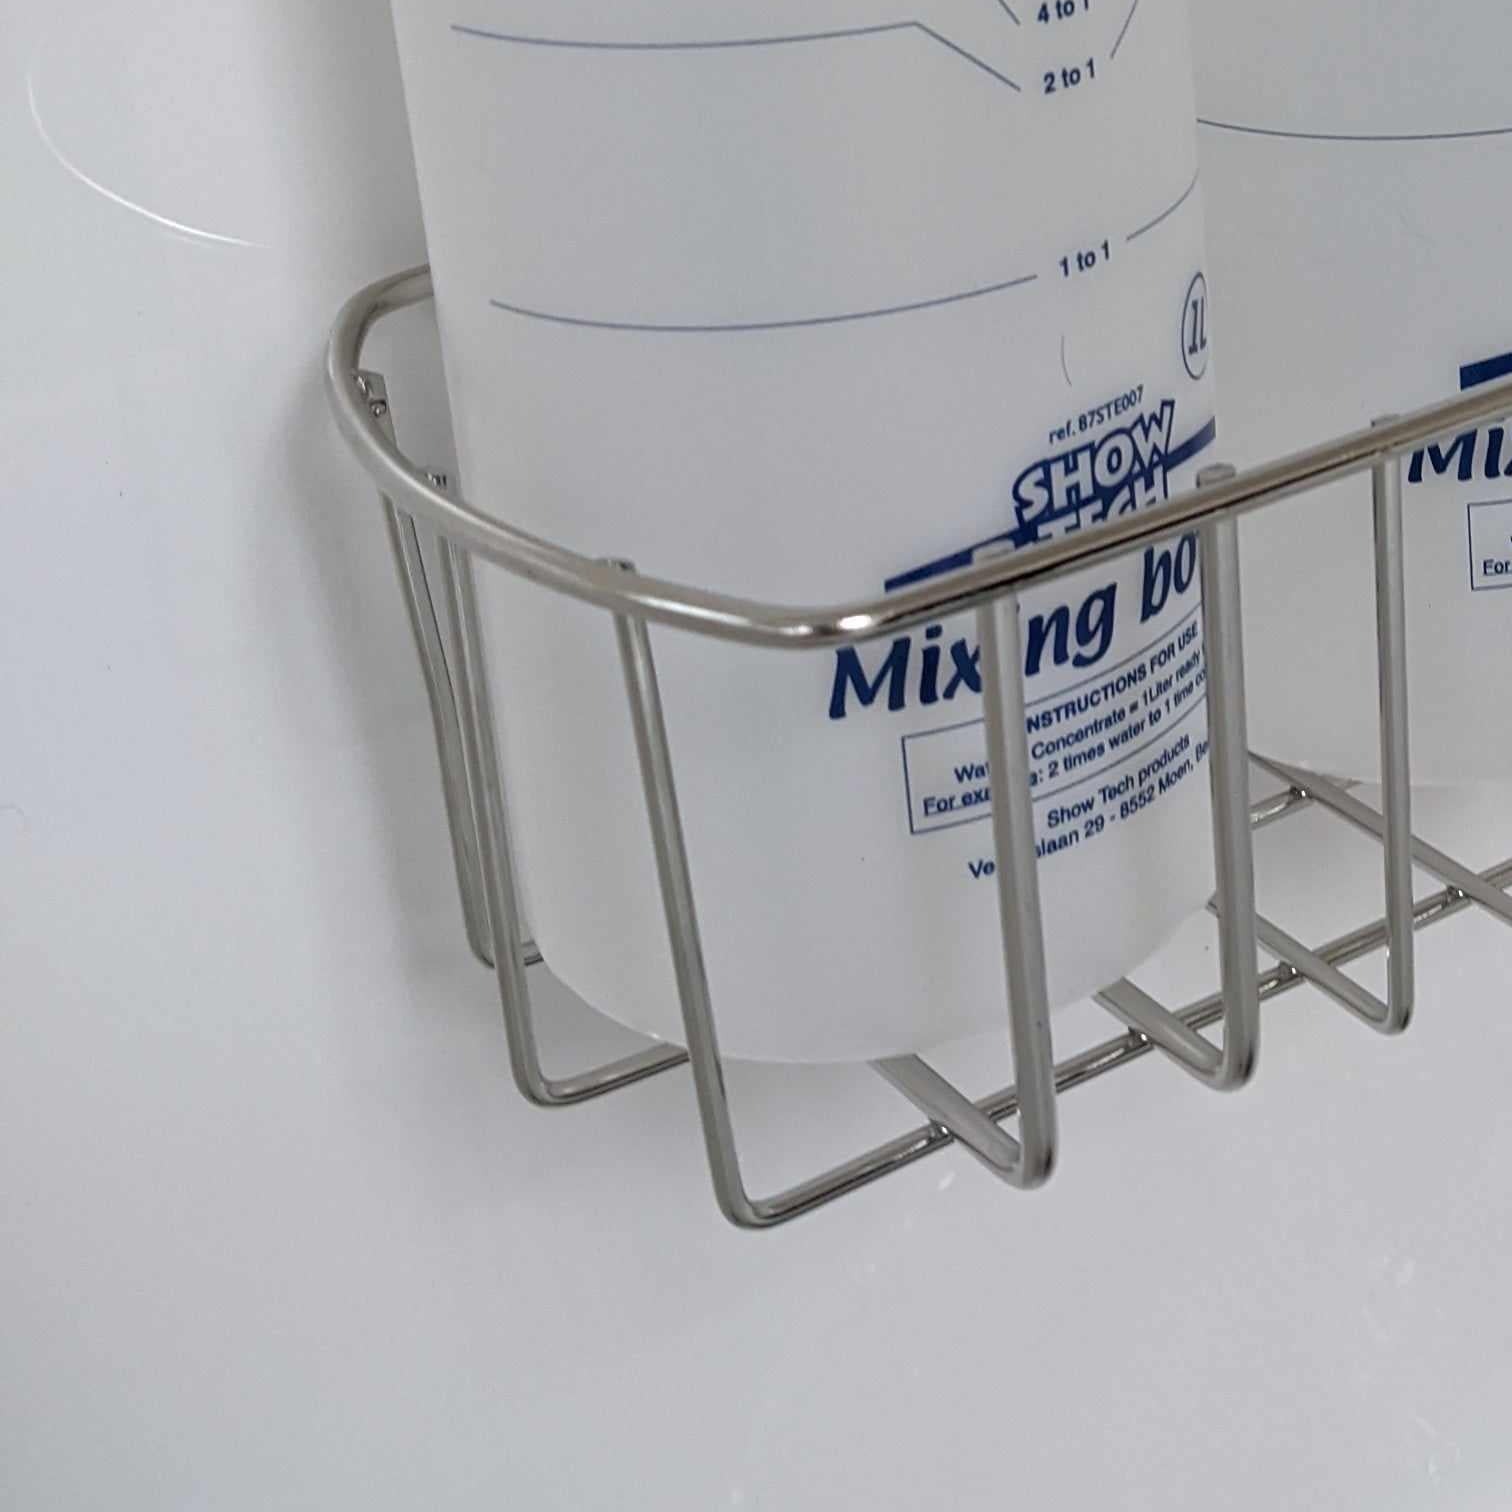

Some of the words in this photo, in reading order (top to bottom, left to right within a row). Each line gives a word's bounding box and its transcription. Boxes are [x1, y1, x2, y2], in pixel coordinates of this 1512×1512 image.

[1037, 1, 1051, 24] 4
[1043, 71, 1057, 95] 2
[1061, 67, 1081, 89] to
[1085, 57, 1095, 79] 1
[1059, 256, 1069, 278] 1
[1076, 250, 1097, 273] to
[1100, 239, 1110, 261] 1
[1049, 420, 1076, 444] ref.
[1079, 384, 1144, 432] 87STE007
[1013, 400, 1175, 528] SHOW
[829, 582, 1117, 719] Mixng
[1048, 795, 1095, 829] Show
[1098, 775, 1135, 804] Tech
[1138, 734, 1190, 785] products
